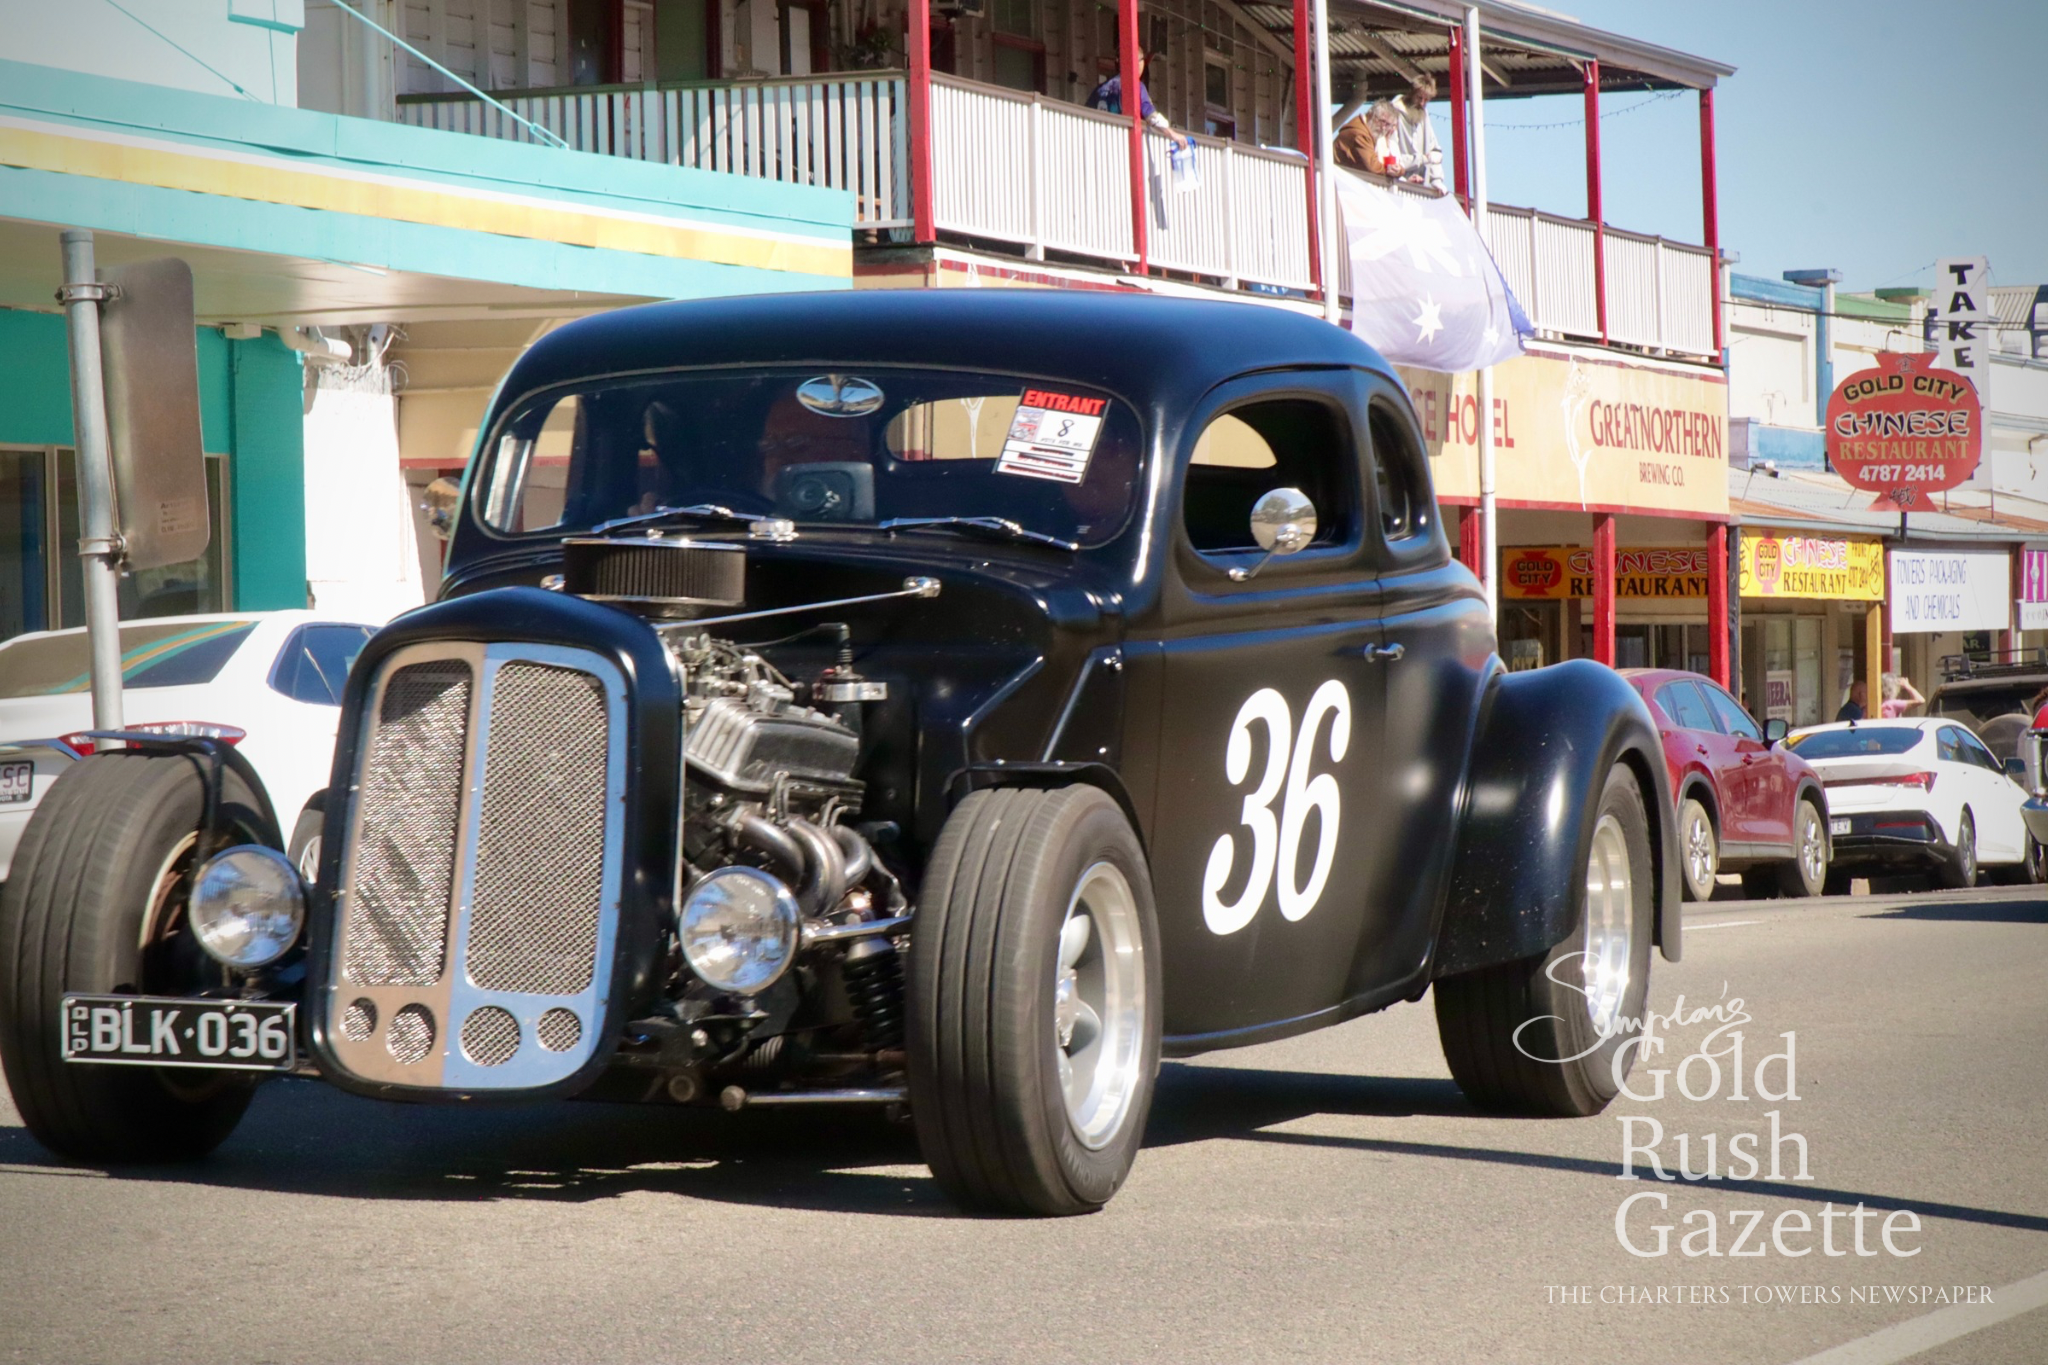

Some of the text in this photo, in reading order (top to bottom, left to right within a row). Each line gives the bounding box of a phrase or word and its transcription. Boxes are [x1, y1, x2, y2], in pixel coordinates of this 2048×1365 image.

[1948, 264, 1977, 368] TAKE
[1843, 374, 1966, 404] GOLD CITY
[1022, 390, 1105, 415] ENTRANT
[1057, 419, 1075, 437] 8
[1445, 394, 1515, 448] HOEL
[1590, 400, 1722, 460] GREATNORTHERN
[1835, 410, 1970, 438] CHINESE
[1840, 440, 1970, 460] RESTAURANT
[1639, 461, 1685, 487] BREWING CO.
[1858, 464, 1946, 482] 4787 2414
[1758, 544, 1777, 559] GOLD
[1782, 535, 1847, 570] CHINESE
[1516, 560, 1554, 573] GOLD
[1517, 573, 1551, 585] CITY
[1759, 563, 1776, 579] CITY
[1897, 559, 1925, 585] TOWERS
[1929, 559, 1967, 585] PACKAGING
[1570, 577, 1708, 596] RETAURANT
[1783, 571, 1846, 594] RESTAURANT
[1905, 594, 1960, 620] AND CHEMICALS
[0, 765, 29, 789] SC
[1202, 679, 1351, 936] 36
